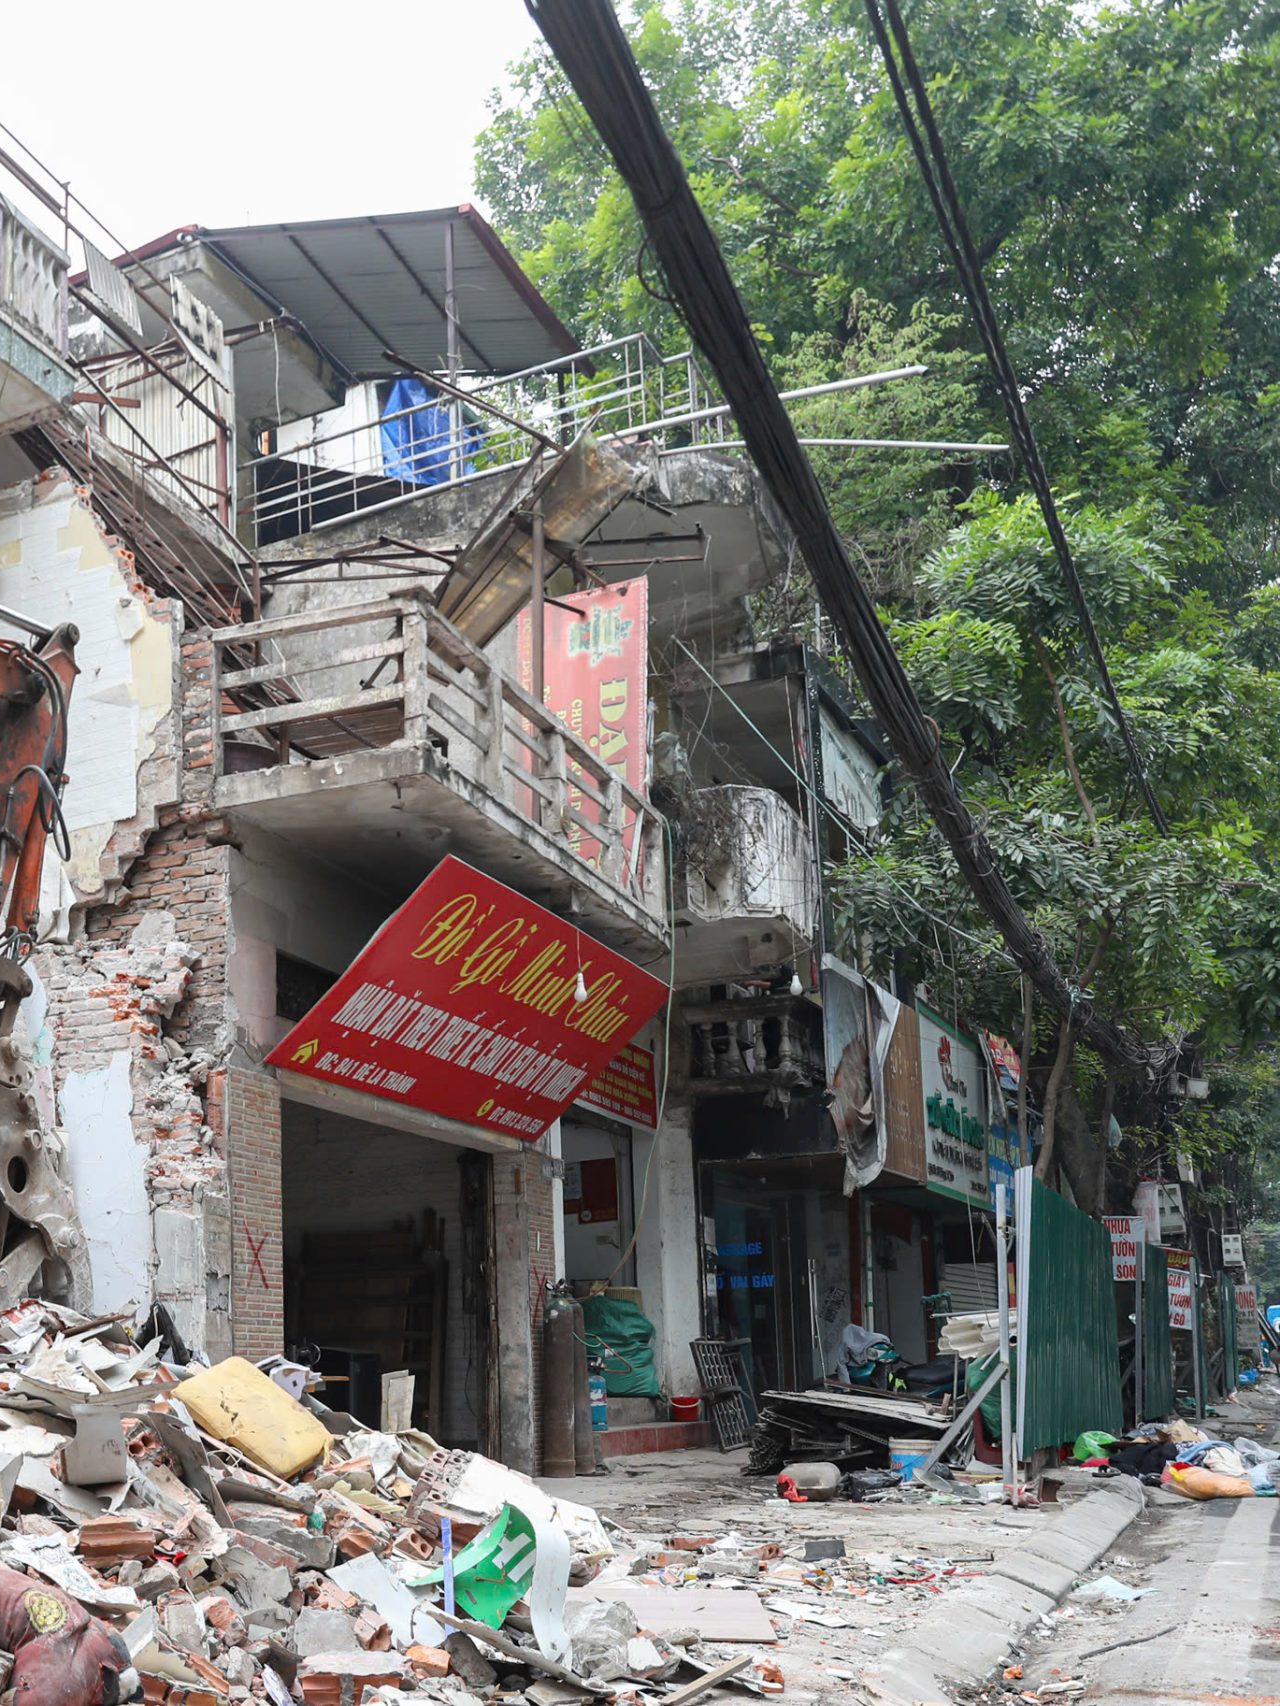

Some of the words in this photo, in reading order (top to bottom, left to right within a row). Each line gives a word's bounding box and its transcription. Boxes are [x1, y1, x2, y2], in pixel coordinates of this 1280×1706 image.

[330, 979, 398, 1038] NHẬN
[498, 939, 592, 1017] Minh
[565, 972, 630, 1042] Châu
[395, 1004, 450, 1051] THEO
[425, 1011, 487, 1062] THIẾT
[454, 1019, 504, 1068] KẾ
[470, 1027, 526, 1077] CHẤT
[334, 1057, 360, 1077] 841
[367, 1067, 387, 1086] LA
[379, 1071, 418, 1095] THÀNH
[494, 1040, 539, 1090] LIỆU
[1111, 1237, 1137, 1257] TƯỜN
[1170, 1290, 1193, 1309] TƯỜN
